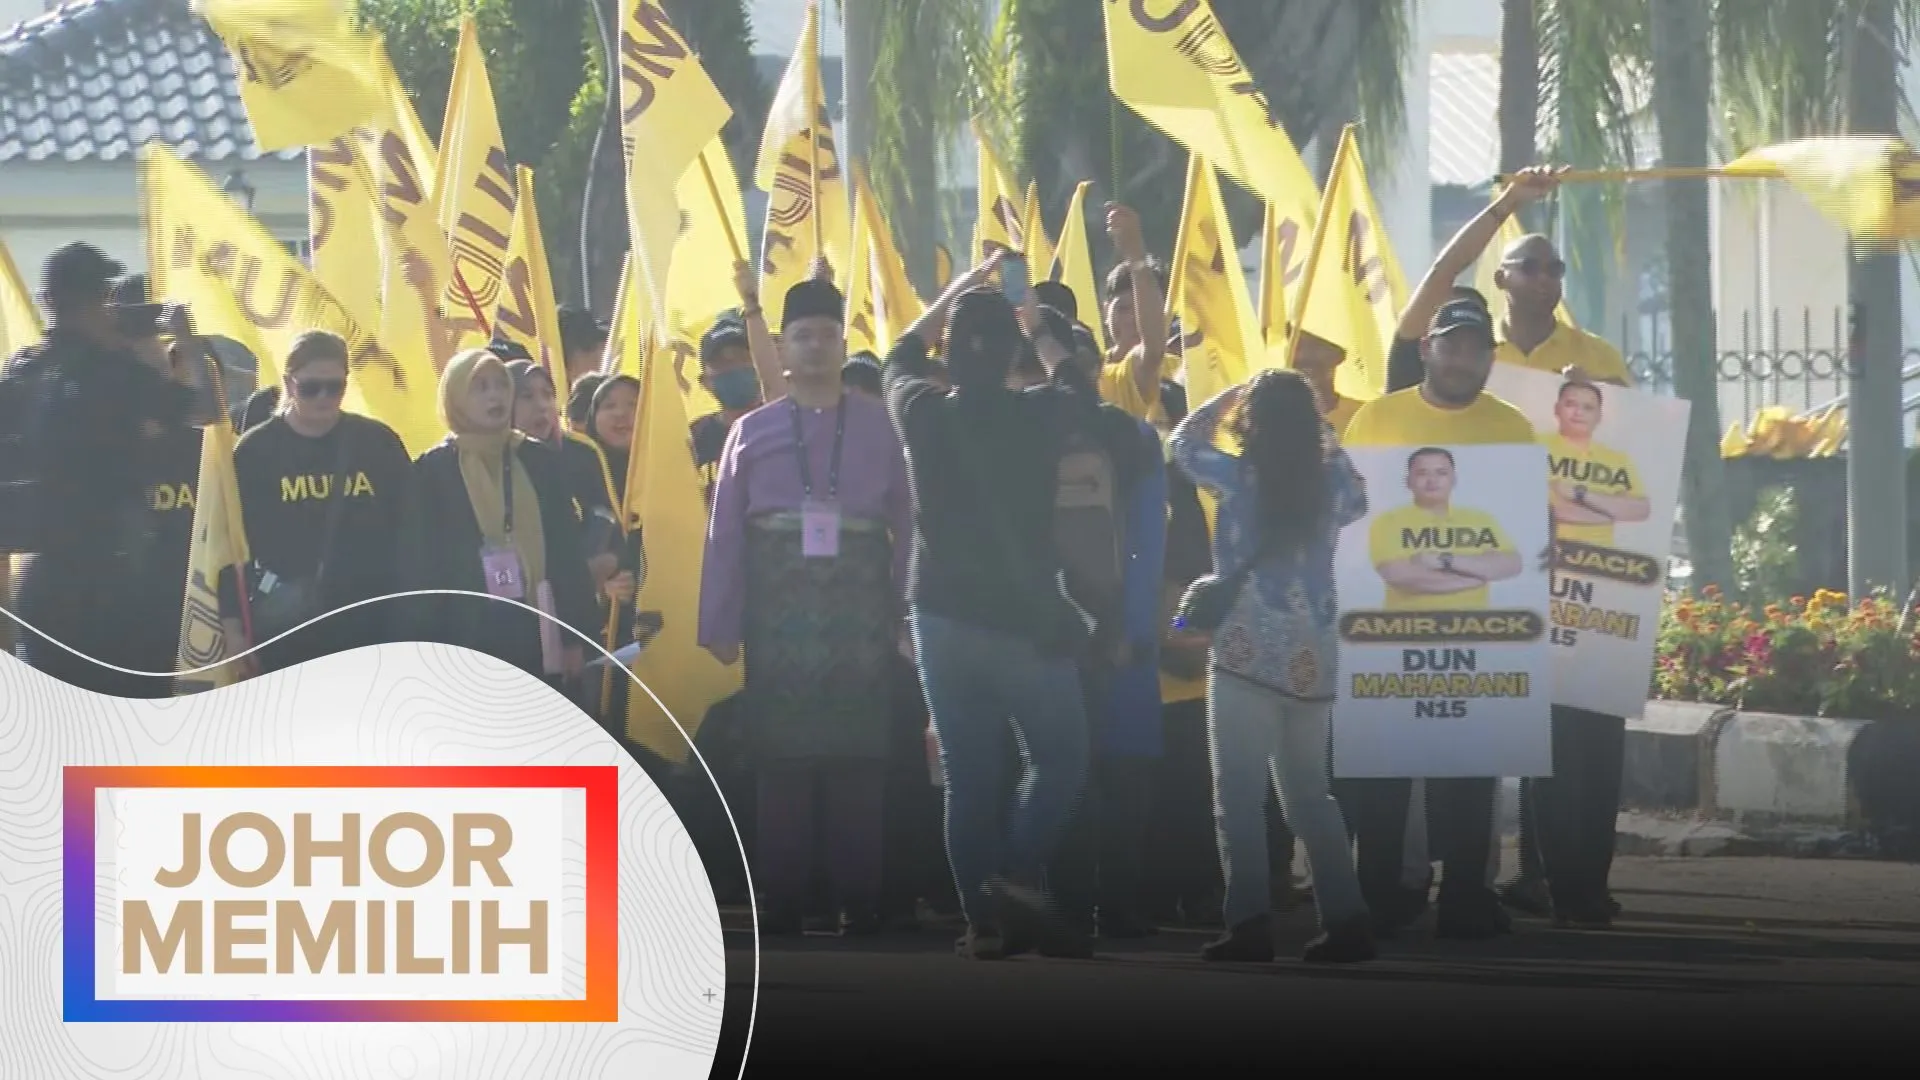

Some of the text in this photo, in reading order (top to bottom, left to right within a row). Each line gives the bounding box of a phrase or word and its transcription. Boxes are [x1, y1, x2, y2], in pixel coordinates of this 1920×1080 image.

[1547, 453, 1632, 490] MUDA
[1401, 527, 1499, 548] MUDA
[1565, 549, 1648, 579] JACK
[1549, 568, 1593, 603] UN
[1350, 617, 1529, 635] AMIR JACK
[1402, 649, 1476, 672] DUN
[1352, 672, 1530, 698] MAHARANI
[1414, 700, 1467, 718] N15
